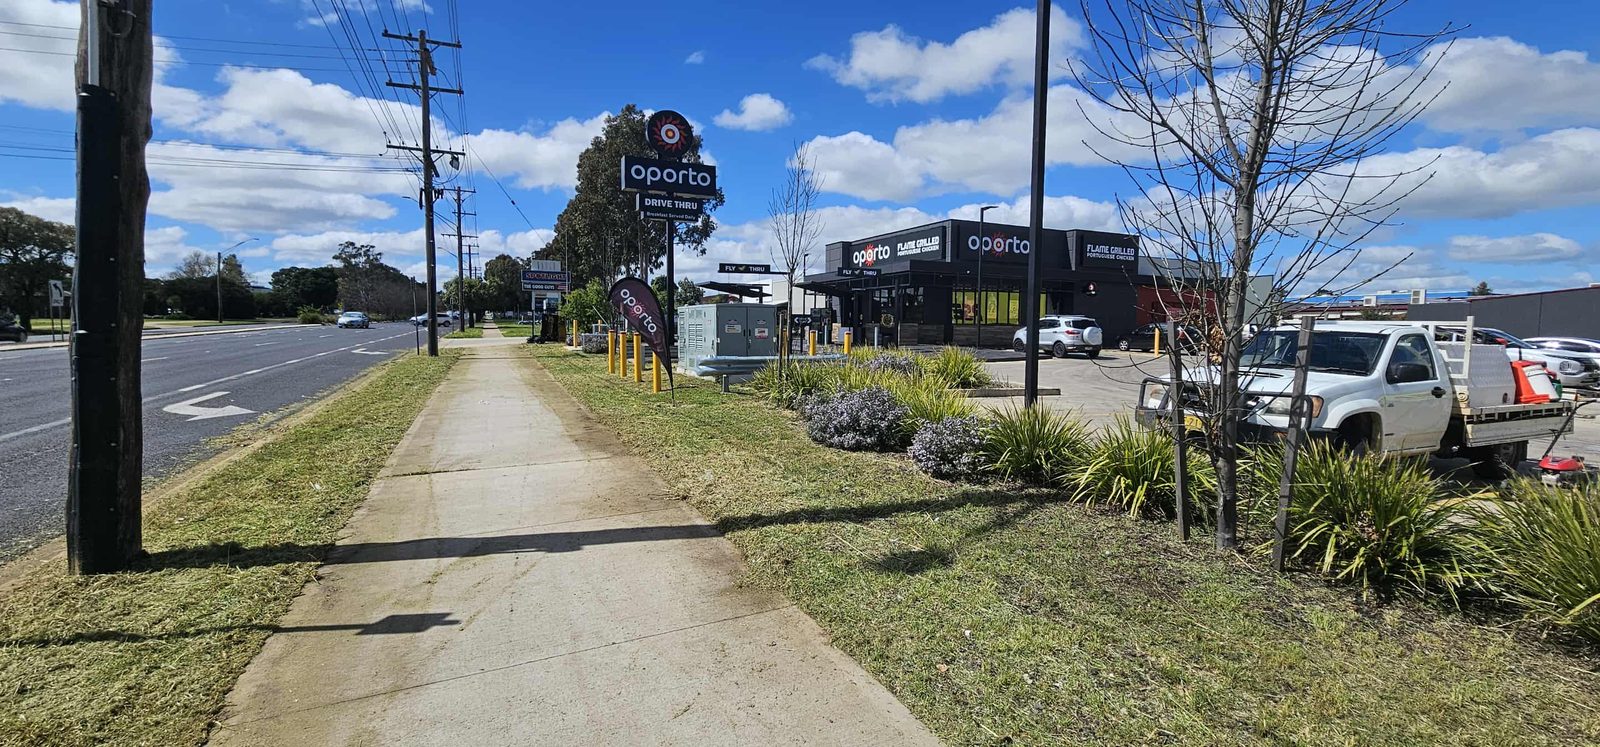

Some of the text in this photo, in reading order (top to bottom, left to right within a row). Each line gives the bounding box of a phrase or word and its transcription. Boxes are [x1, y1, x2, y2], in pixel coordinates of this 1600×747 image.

[631, 165, 711, 186] oporto
[645, 198, 697, 210] DRIVE THRU
[897, 236, 940, 251] FLAME GRILLED
[897, 248, 921, 256] PORTUGUESE
[968, 235, 1030, 256] oporto
[1087, 245, 1135, 255] FLAME GRILLED
[853, 244, 890, 267] oporto
[620, 289, 656, 332] oporto
